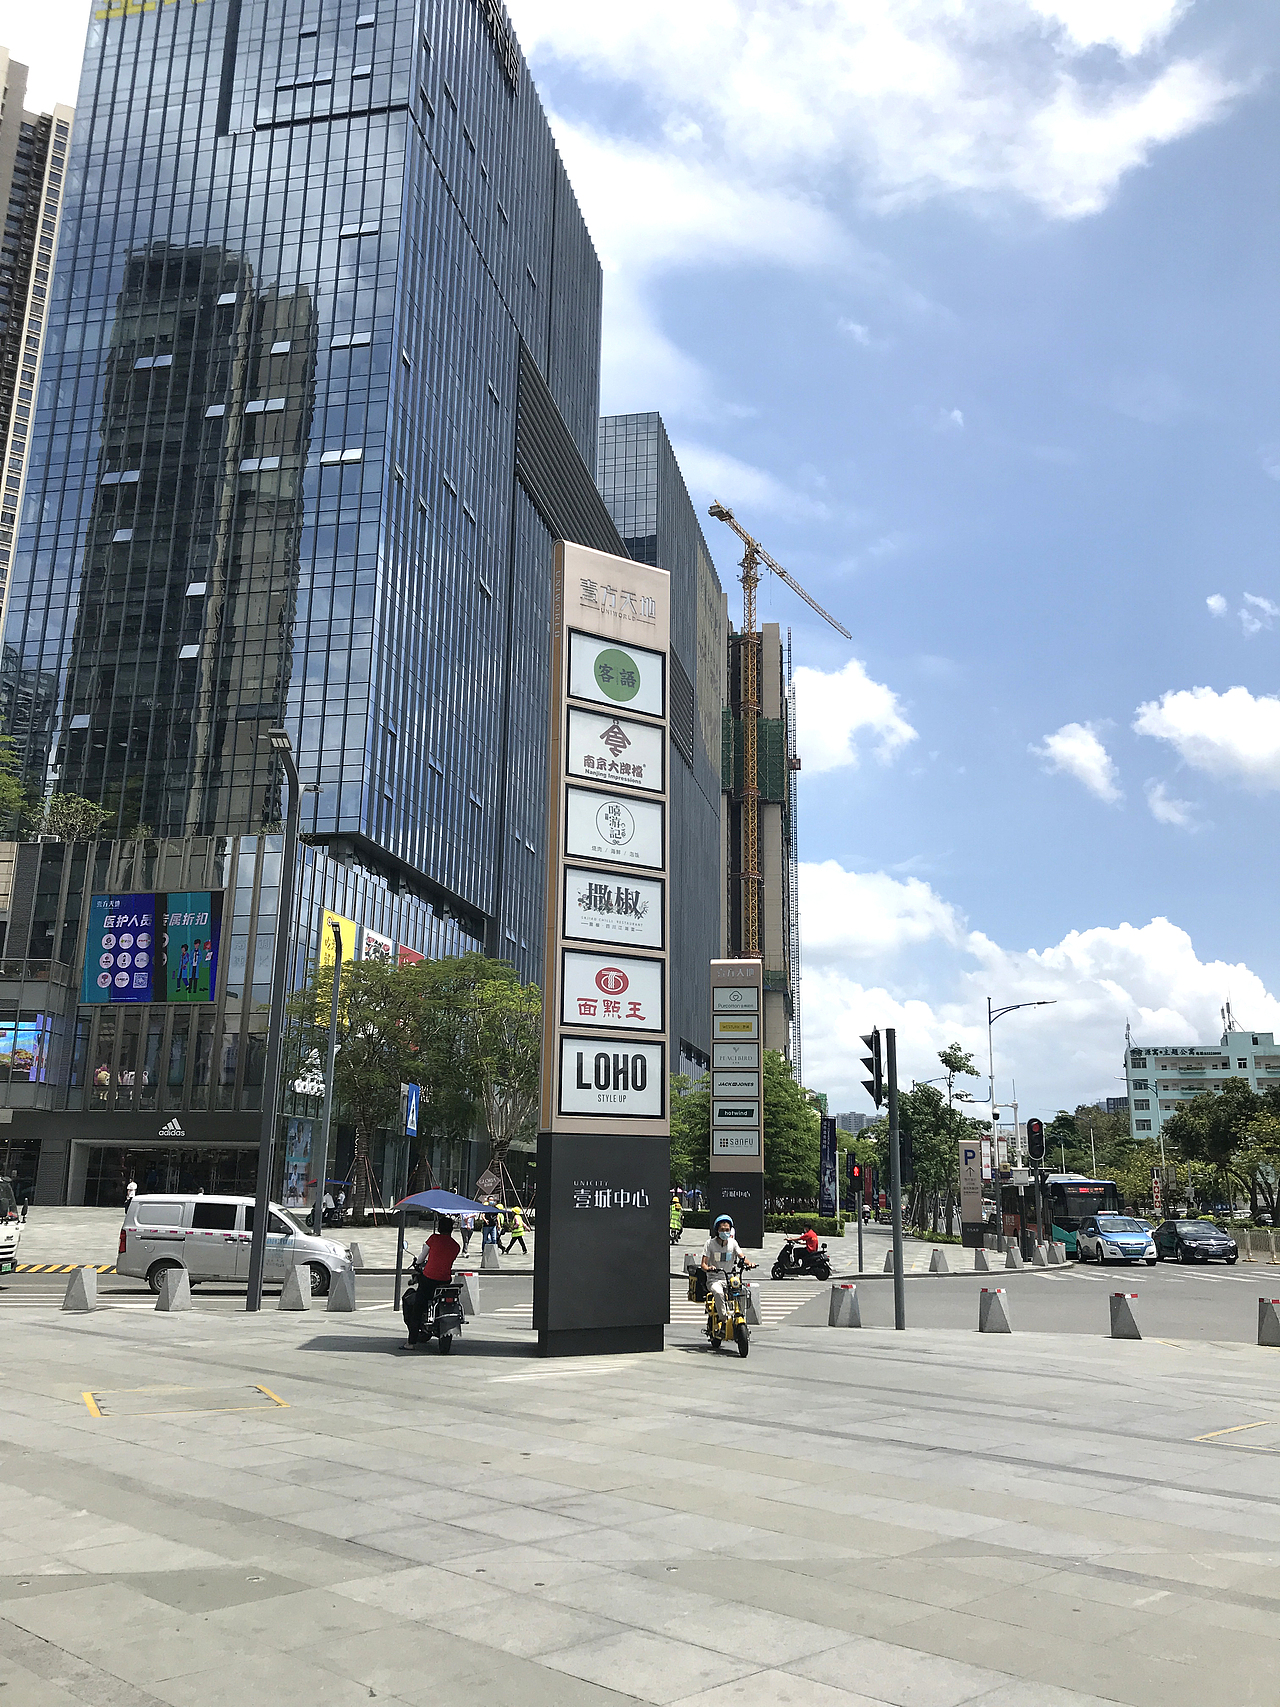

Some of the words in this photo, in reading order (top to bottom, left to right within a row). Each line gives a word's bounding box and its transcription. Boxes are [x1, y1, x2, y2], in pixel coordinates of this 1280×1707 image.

[554, 570, 562, 638] UNIWORLD
[580, 579, 656, 619] 壹方天地
[600, 607, 636, 621] UNIWORLD
[585, 768, 607, 779] Nanjing
[607, 772, 642, 785] Impressions
[103, 914, 152, 929] 医护人员
[576, 997, 647, 1021] 面點王
[576, 1051, 647, 1092] LOHO
[597, 1093, 617, 1103] STYLE
[618, 1094, 627, 1103] UP
[963, 1149, 976, 1166] P
[573, 1188, 649, 1209] 壹城中心
